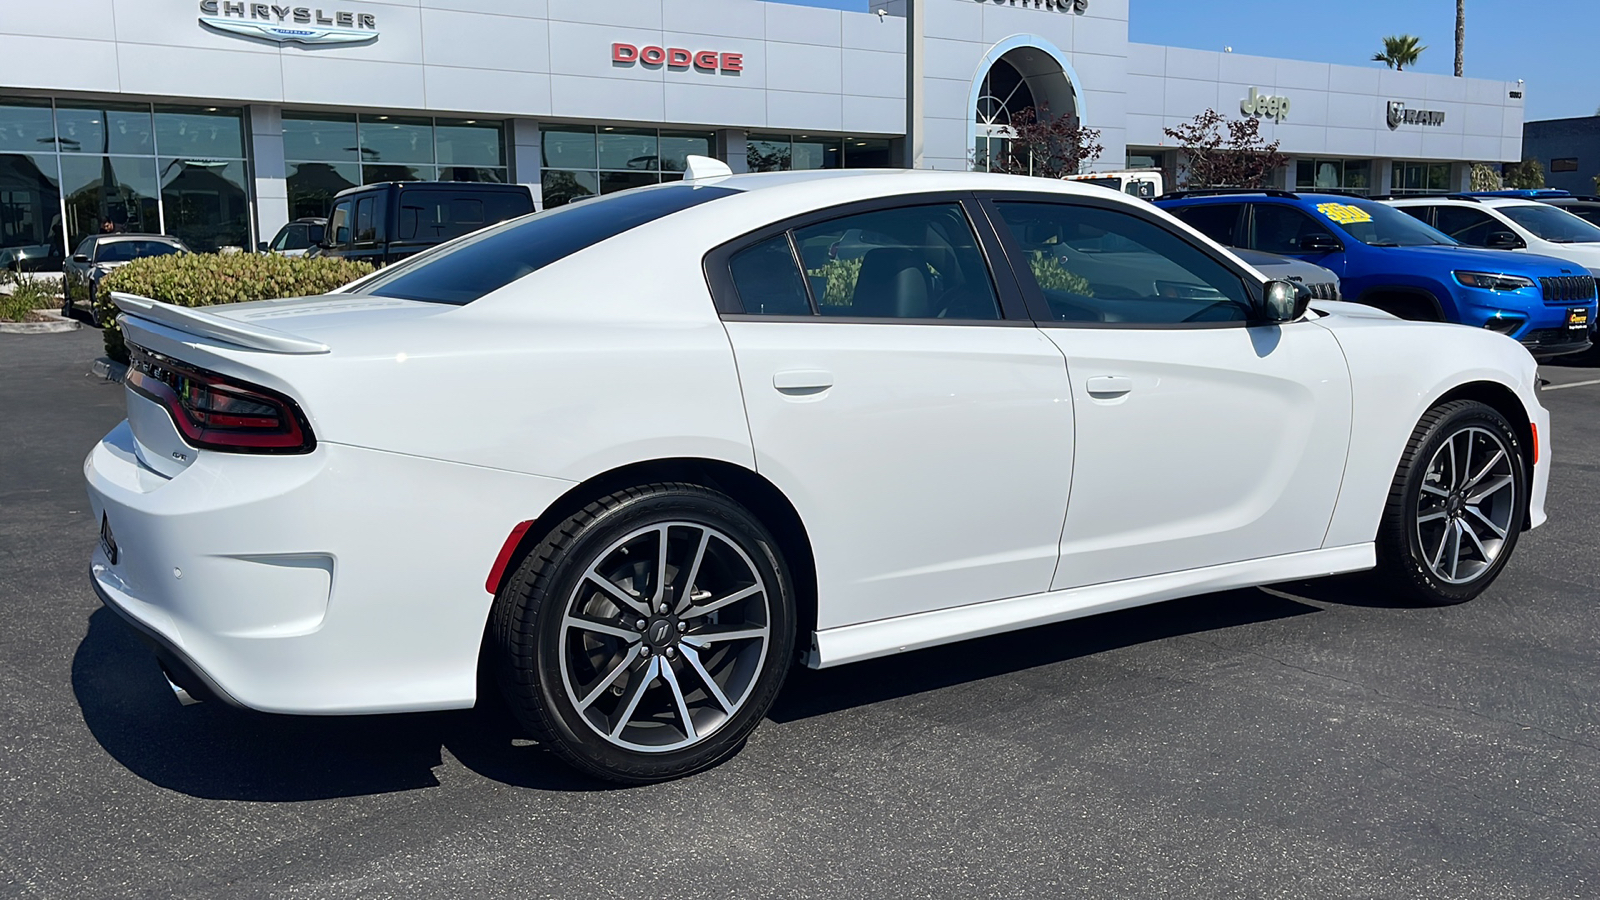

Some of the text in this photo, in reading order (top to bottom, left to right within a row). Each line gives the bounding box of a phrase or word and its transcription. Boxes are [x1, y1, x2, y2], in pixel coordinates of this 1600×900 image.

[200, 0, 376, 29] CHRYSLER
[611, 43, 743, 75] DODGE
[1240, 87, 1290, 122] Jeep
[1404, 109, 1445, 126] RAM
